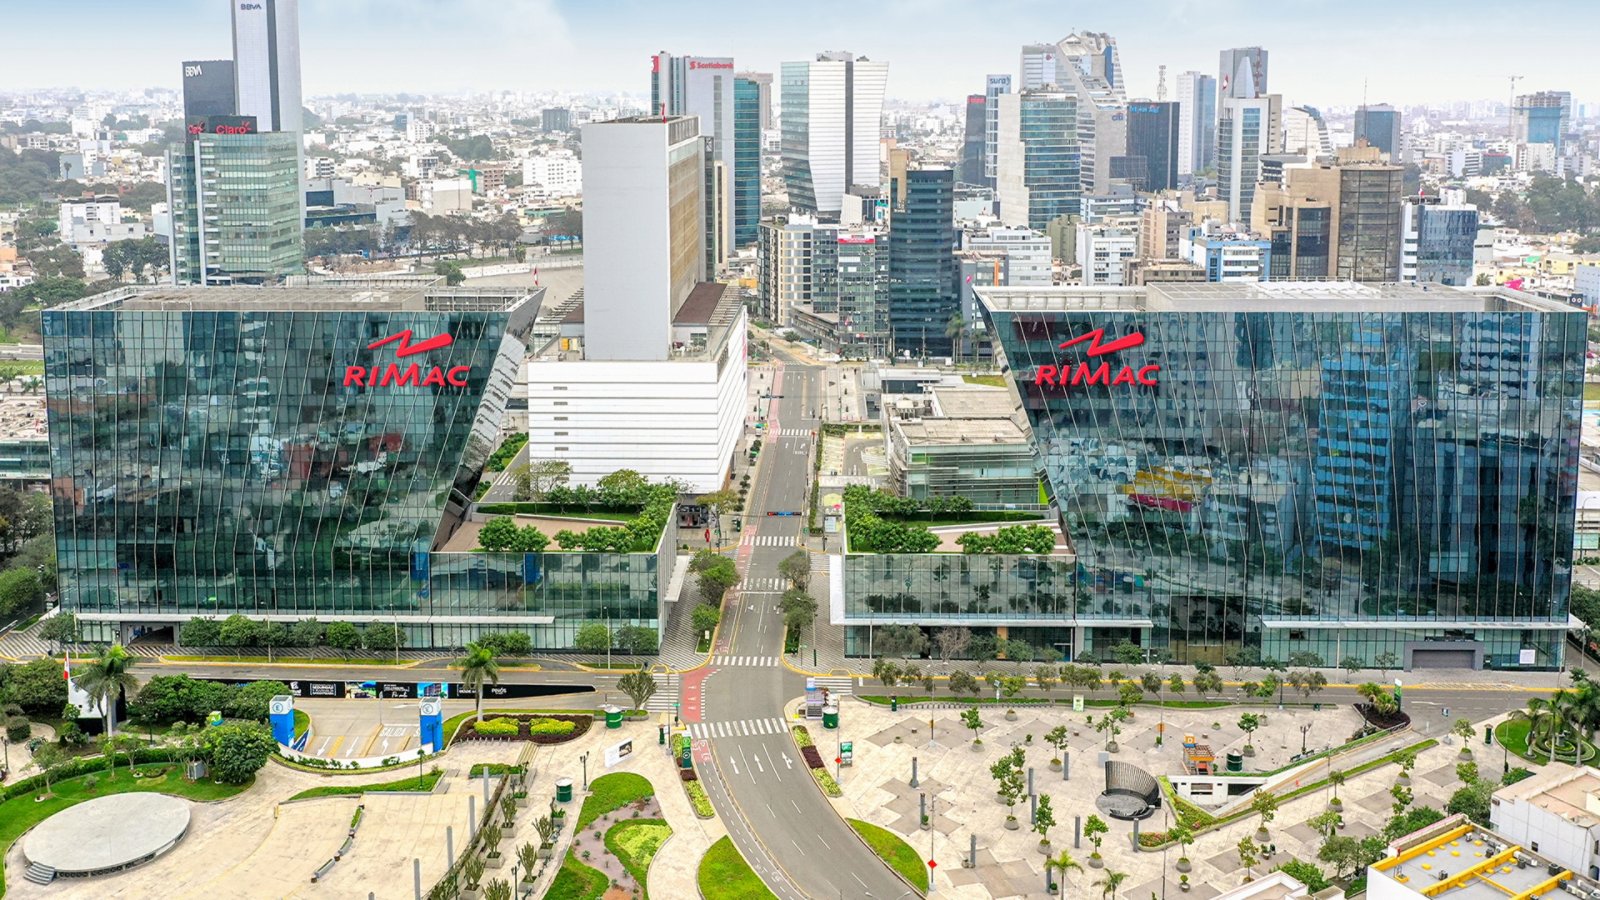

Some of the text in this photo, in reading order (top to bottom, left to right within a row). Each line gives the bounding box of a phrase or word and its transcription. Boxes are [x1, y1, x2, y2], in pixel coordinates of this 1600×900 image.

[185, 64, 202, 77] BBVA
[216, 124, 247, 135] Claro
[343, 362, 471, 387] RIMAC
[1034, 361, 1161, 386] RIMAC
[379, 727, 407, 737] SALIDA
